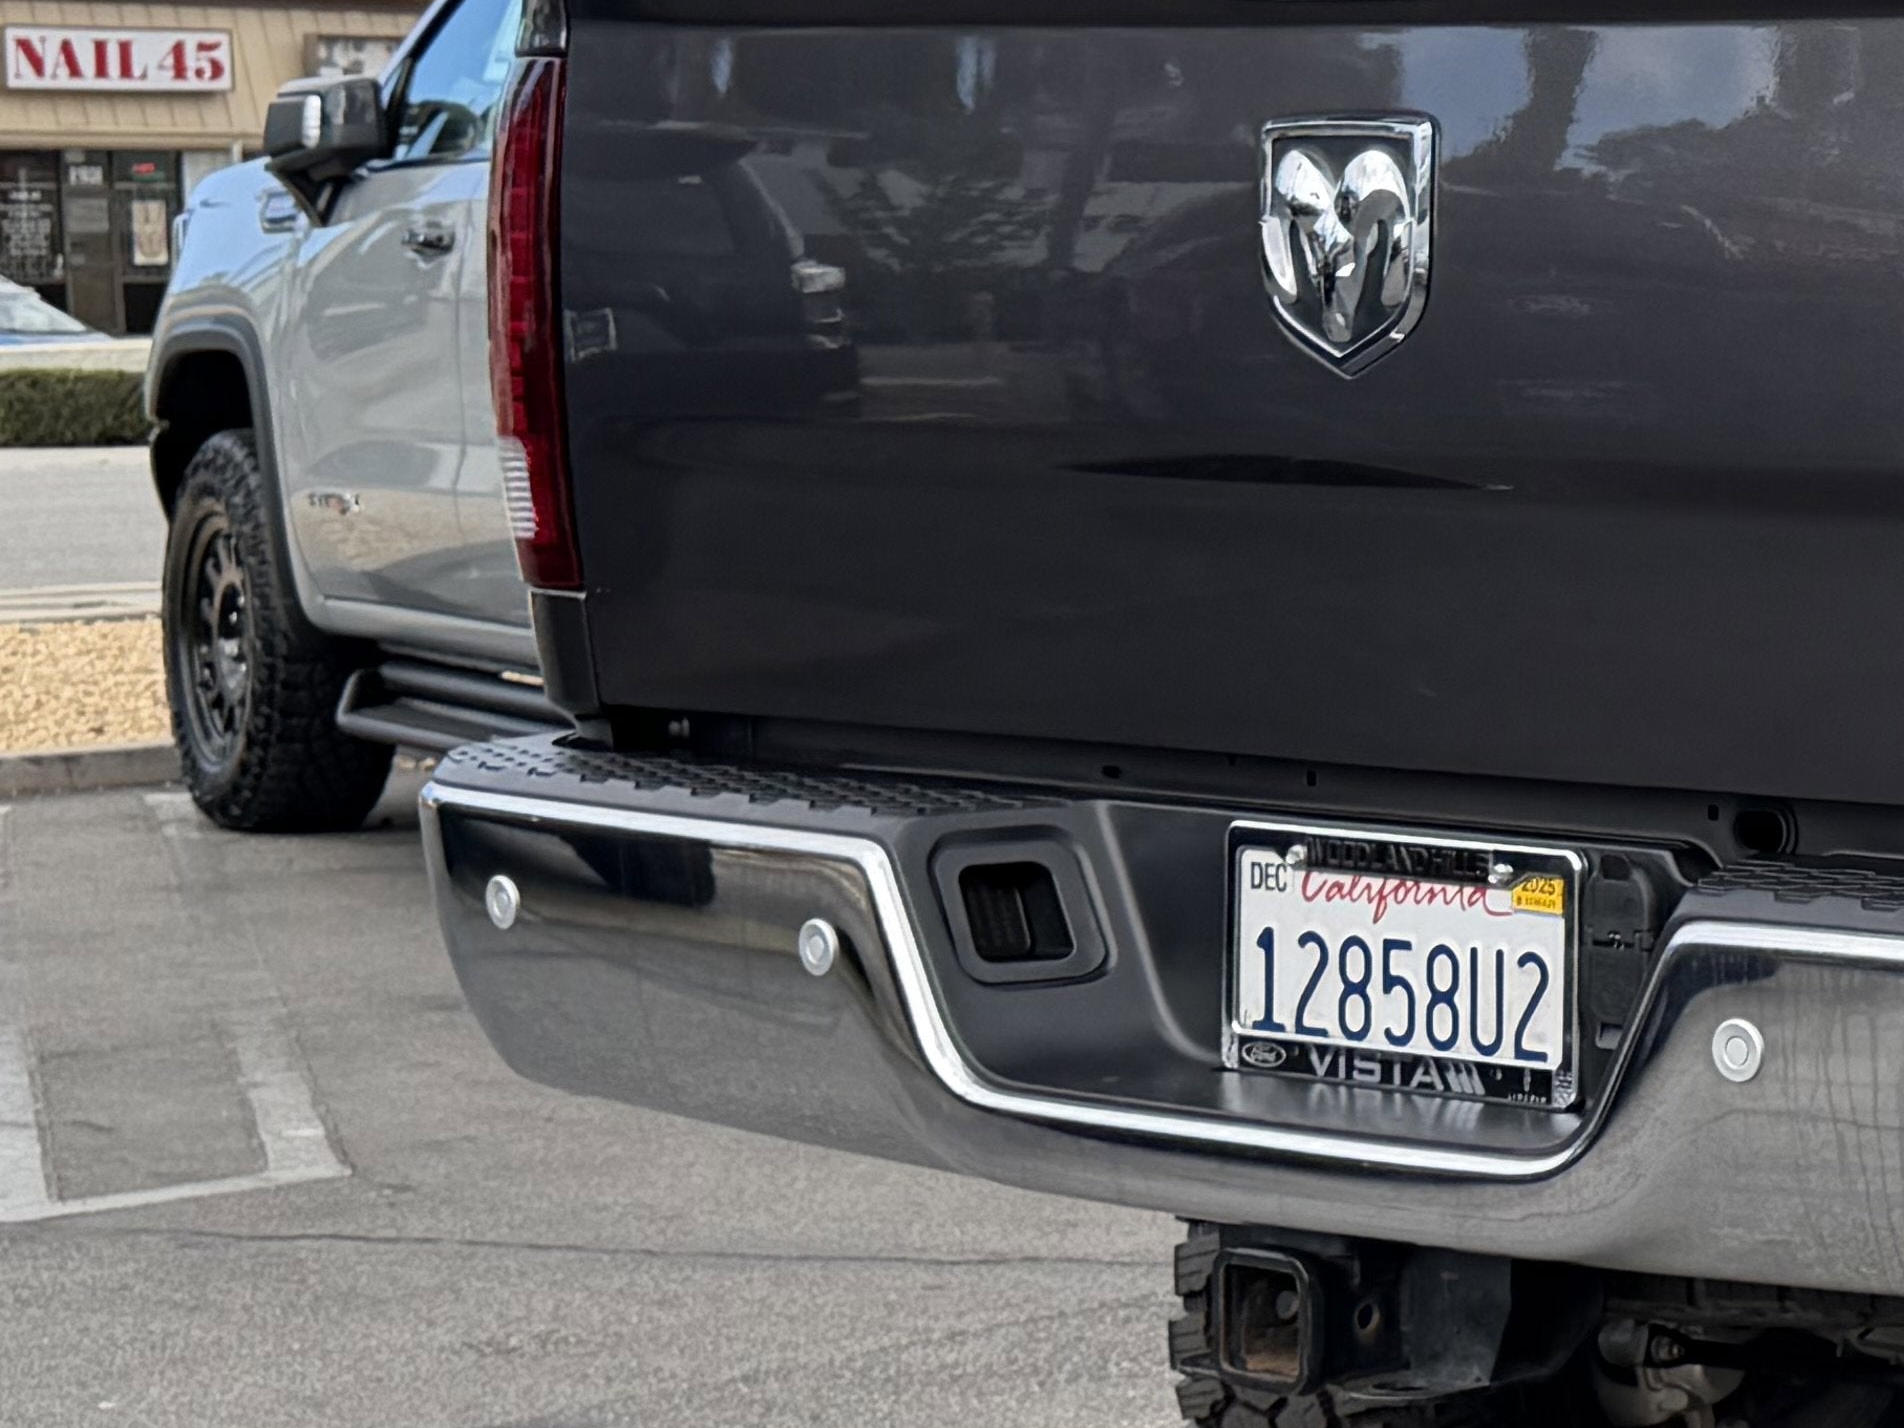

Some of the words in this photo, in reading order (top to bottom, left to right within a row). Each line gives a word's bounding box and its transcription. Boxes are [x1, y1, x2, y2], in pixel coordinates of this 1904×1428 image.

[13, 34, 149, 81] NAIL
[157, 38, 227, 82] 45
[1249, 860, 1288, 893] DEC
[1301, 871, 1513, 925] California
[1250, 925, 1550, 1064] 12858U2
[1308, 1046, 1445, 1092] VISTA
